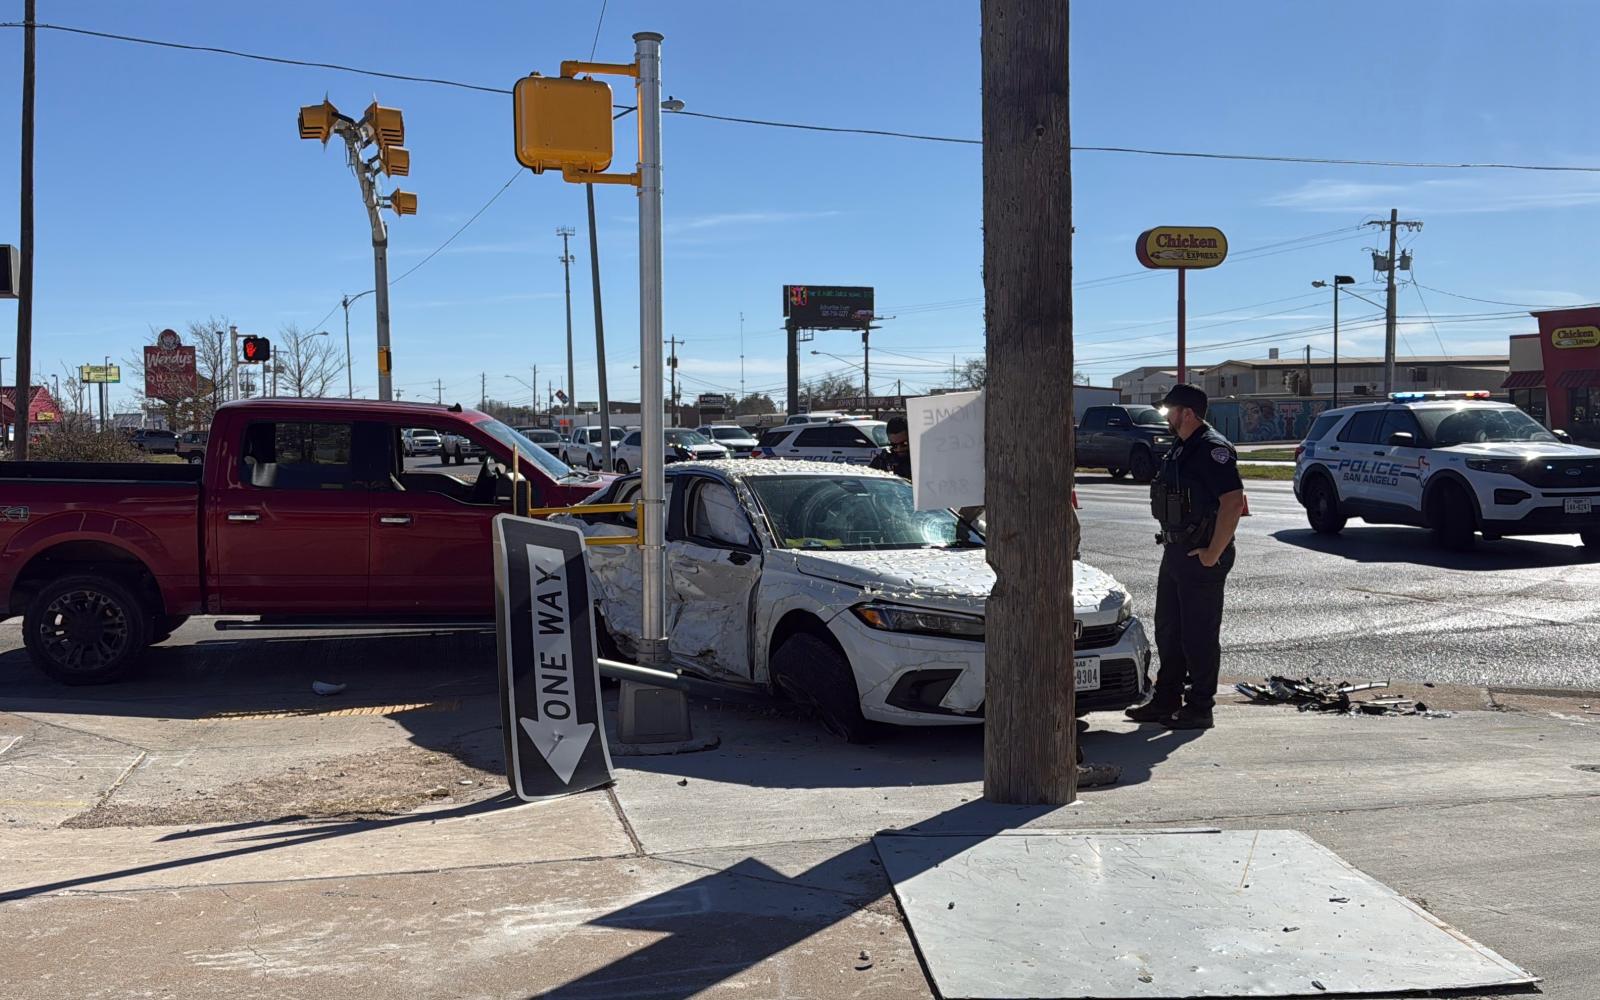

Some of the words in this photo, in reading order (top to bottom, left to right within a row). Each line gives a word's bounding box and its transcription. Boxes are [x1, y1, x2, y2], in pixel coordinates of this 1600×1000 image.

[1156, 234, 1217, 248] Chicken
[1338, 458, 1402, 476] POLICE
[1343, 473, 1361, 482] SAN
[1362, 475, 1399, 487] ANGELO
[535, 564, 566, 635] WAY
[1077, 668, 1098, 685] 9304
[541, 652, 571, 720] ONE
